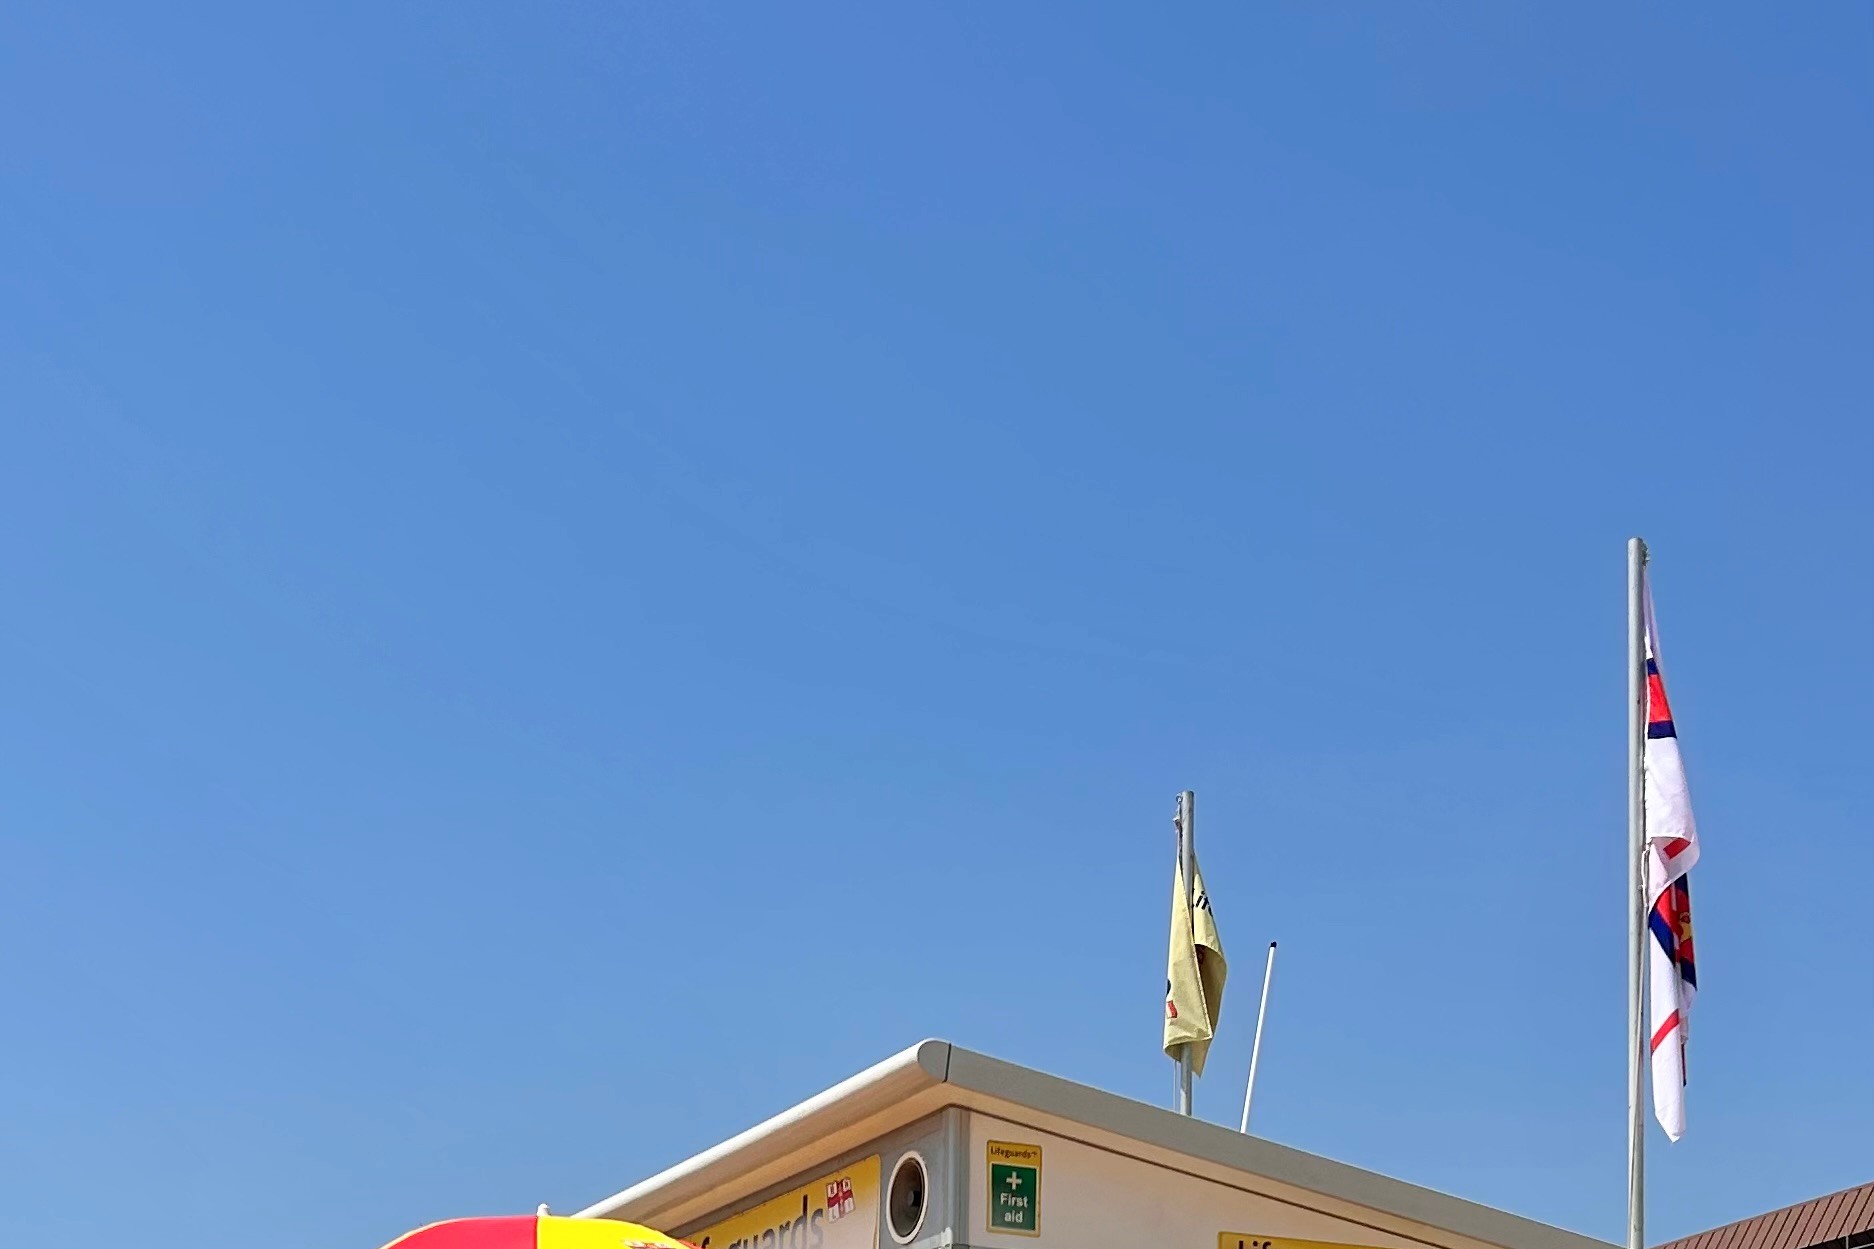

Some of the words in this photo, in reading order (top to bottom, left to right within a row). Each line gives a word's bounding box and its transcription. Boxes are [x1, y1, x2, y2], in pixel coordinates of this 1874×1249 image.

[990, 1145, 1032, 1159] Lifeguards
[1000, 1192, 1028, 1208] First
[1004, 1210, 1024, 1223] aid
